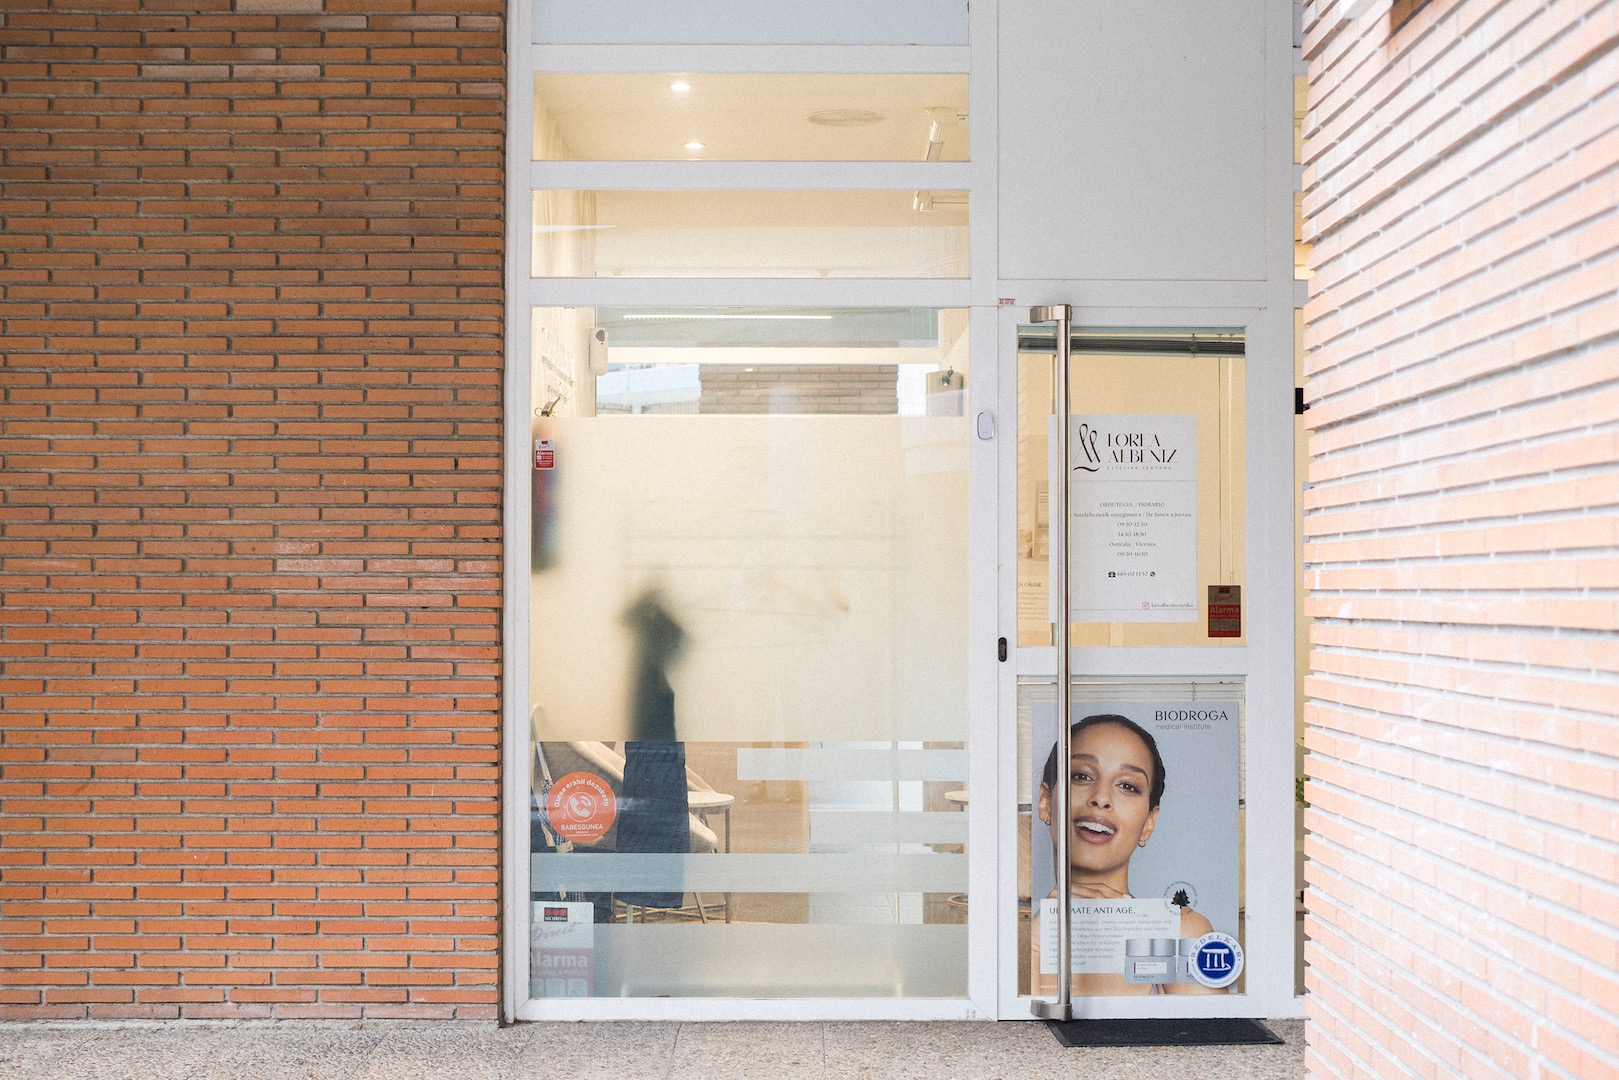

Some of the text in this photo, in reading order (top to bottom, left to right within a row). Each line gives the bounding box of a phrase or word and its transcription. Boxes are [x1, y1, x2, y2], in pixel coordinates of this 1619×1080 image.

[1107, 433, 1160, 447] LOREA
[1107, 449, 1178, 463] ALBENIZ
[1209, 605, 1239, 614] Alarma
[1155, 710, 1228, 721] BIODROGA
[554, 778, 610, 807] Gurea erabil dezakezu
[560, 823, 604, 831] BABESGUNEA
[1093, 906, 1113, 915] ANTI
[1115, 906, 1136, 915] AGE.
[1190, 934, 1241, 959] BEDELKAR
